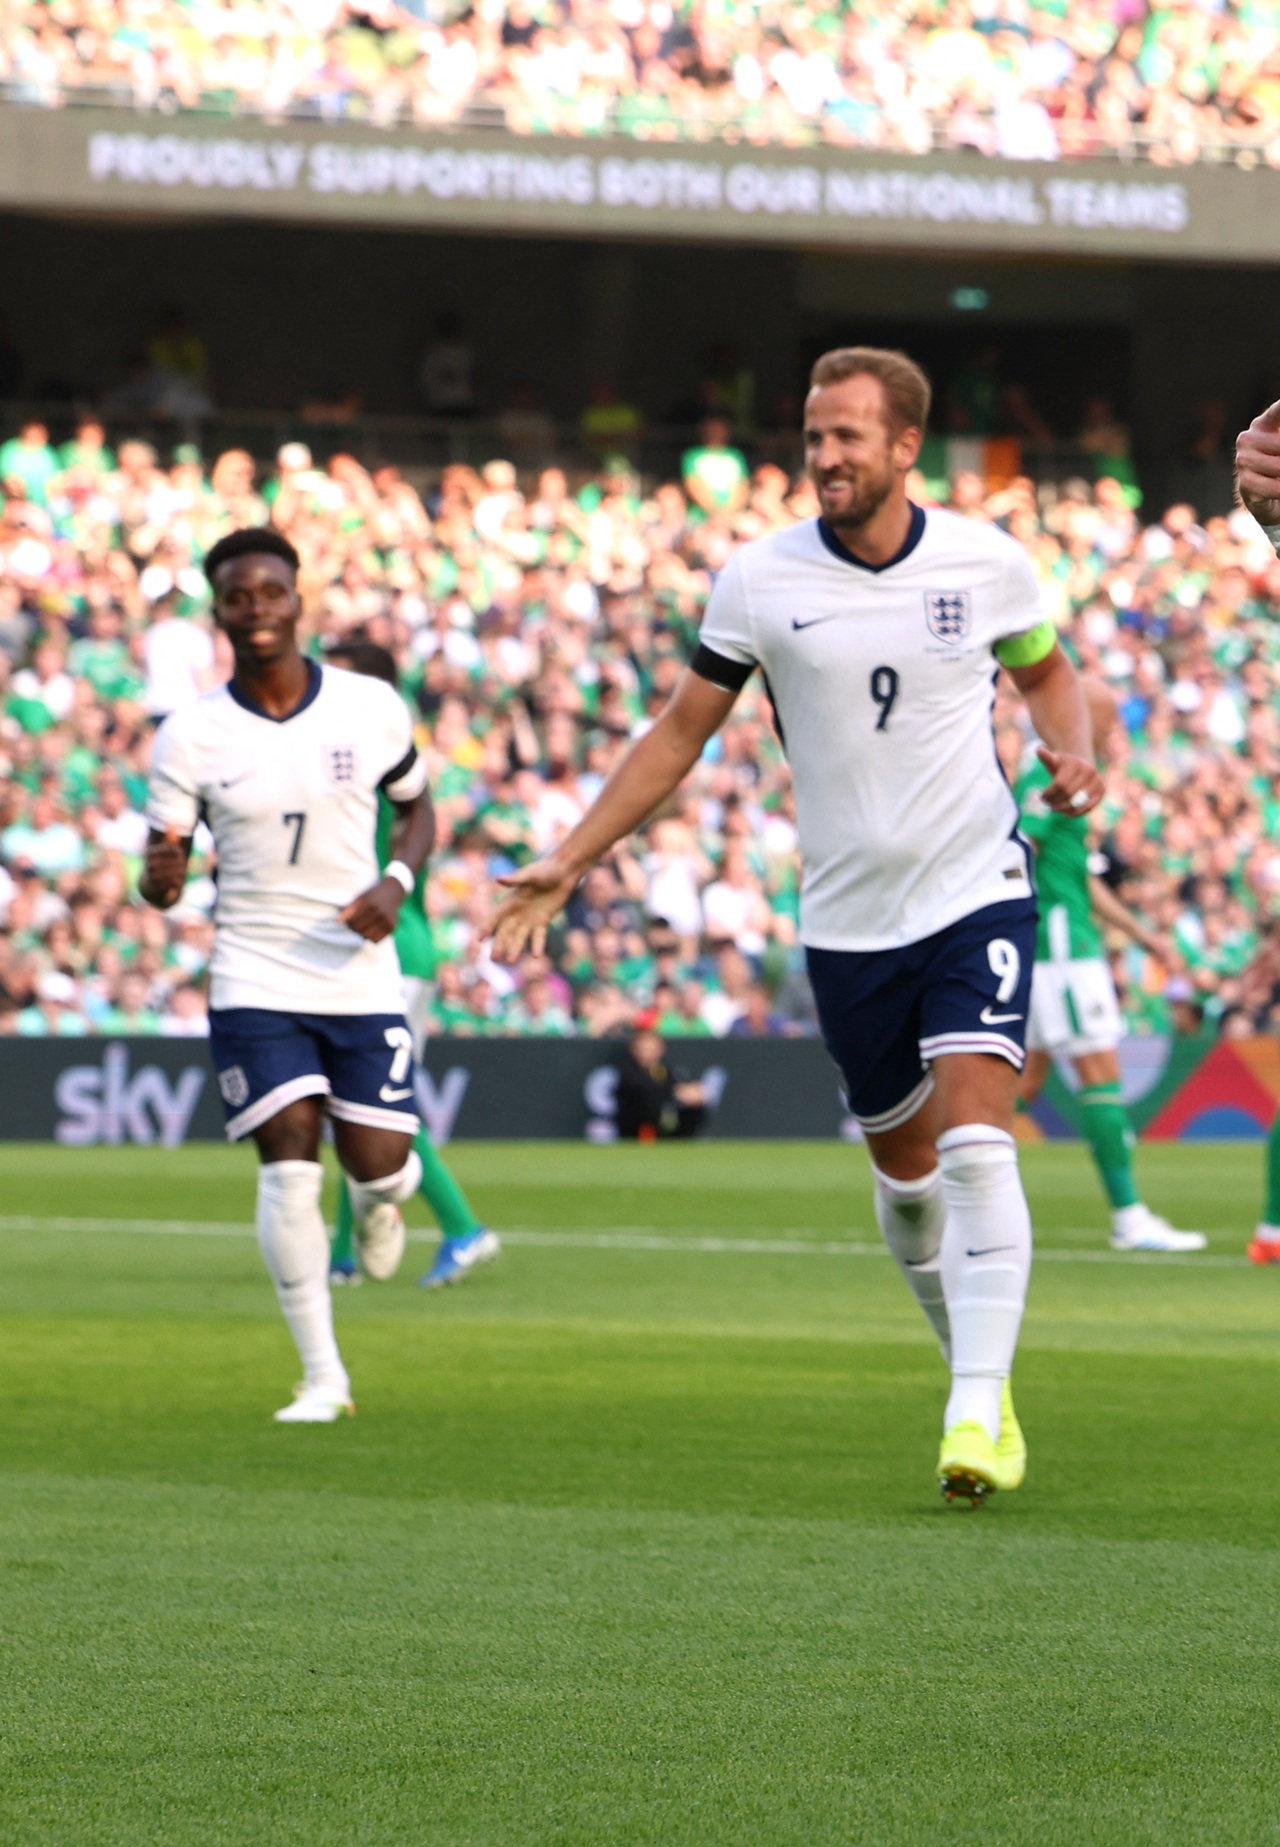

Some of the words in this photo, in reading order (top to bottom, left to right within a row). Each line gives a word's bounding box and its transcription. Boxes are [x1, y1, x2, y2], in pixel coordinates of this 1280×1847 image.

[88, 131, 304, 189] PROUDLY
[308, 141, 595, 205] SUPPORTING
[600, 155, 722, 209] BOTH
[726, 161, 821, 216] OUR
[824, 166, 1041, 226] NATIONAL
[1042, 177, 1189, 232] TEAMS
[870, 666, 899, 731] 9
[282, 811, 307, 866] 7
[986, 937, 1021, 1004] 9
[383, 1026, 413, 1084] 7
[55, 1040, 206, 1150] sky
